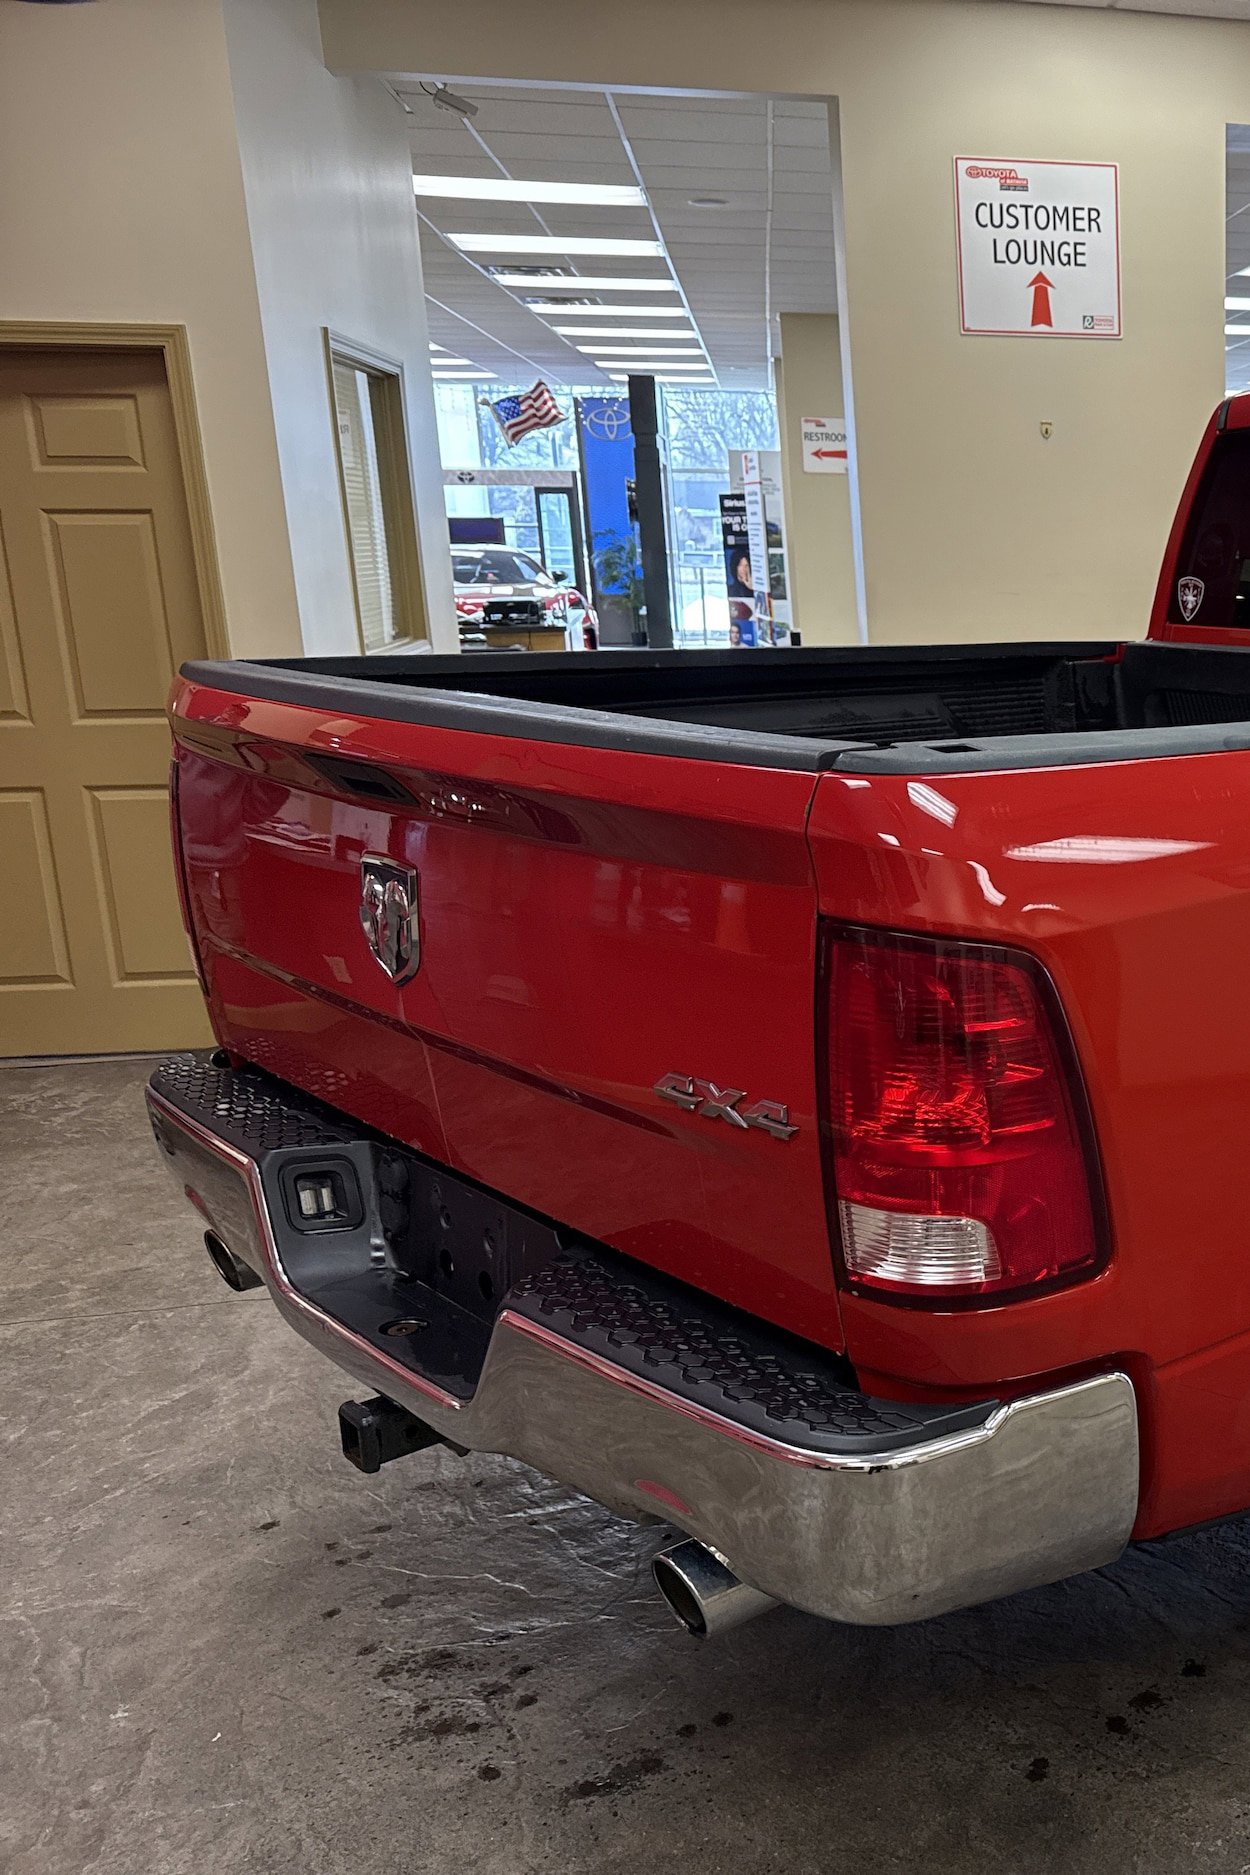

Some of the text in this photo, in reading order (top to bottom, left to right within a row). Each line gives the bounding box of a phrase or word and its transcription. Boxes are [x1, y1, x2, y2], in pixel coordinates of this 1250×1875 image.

[982, 168, 1017, 178] TOYOTA
[974, 201, 1102, 233] CUSTOMER
[993, 238, 1087, 267] LOUNGE
